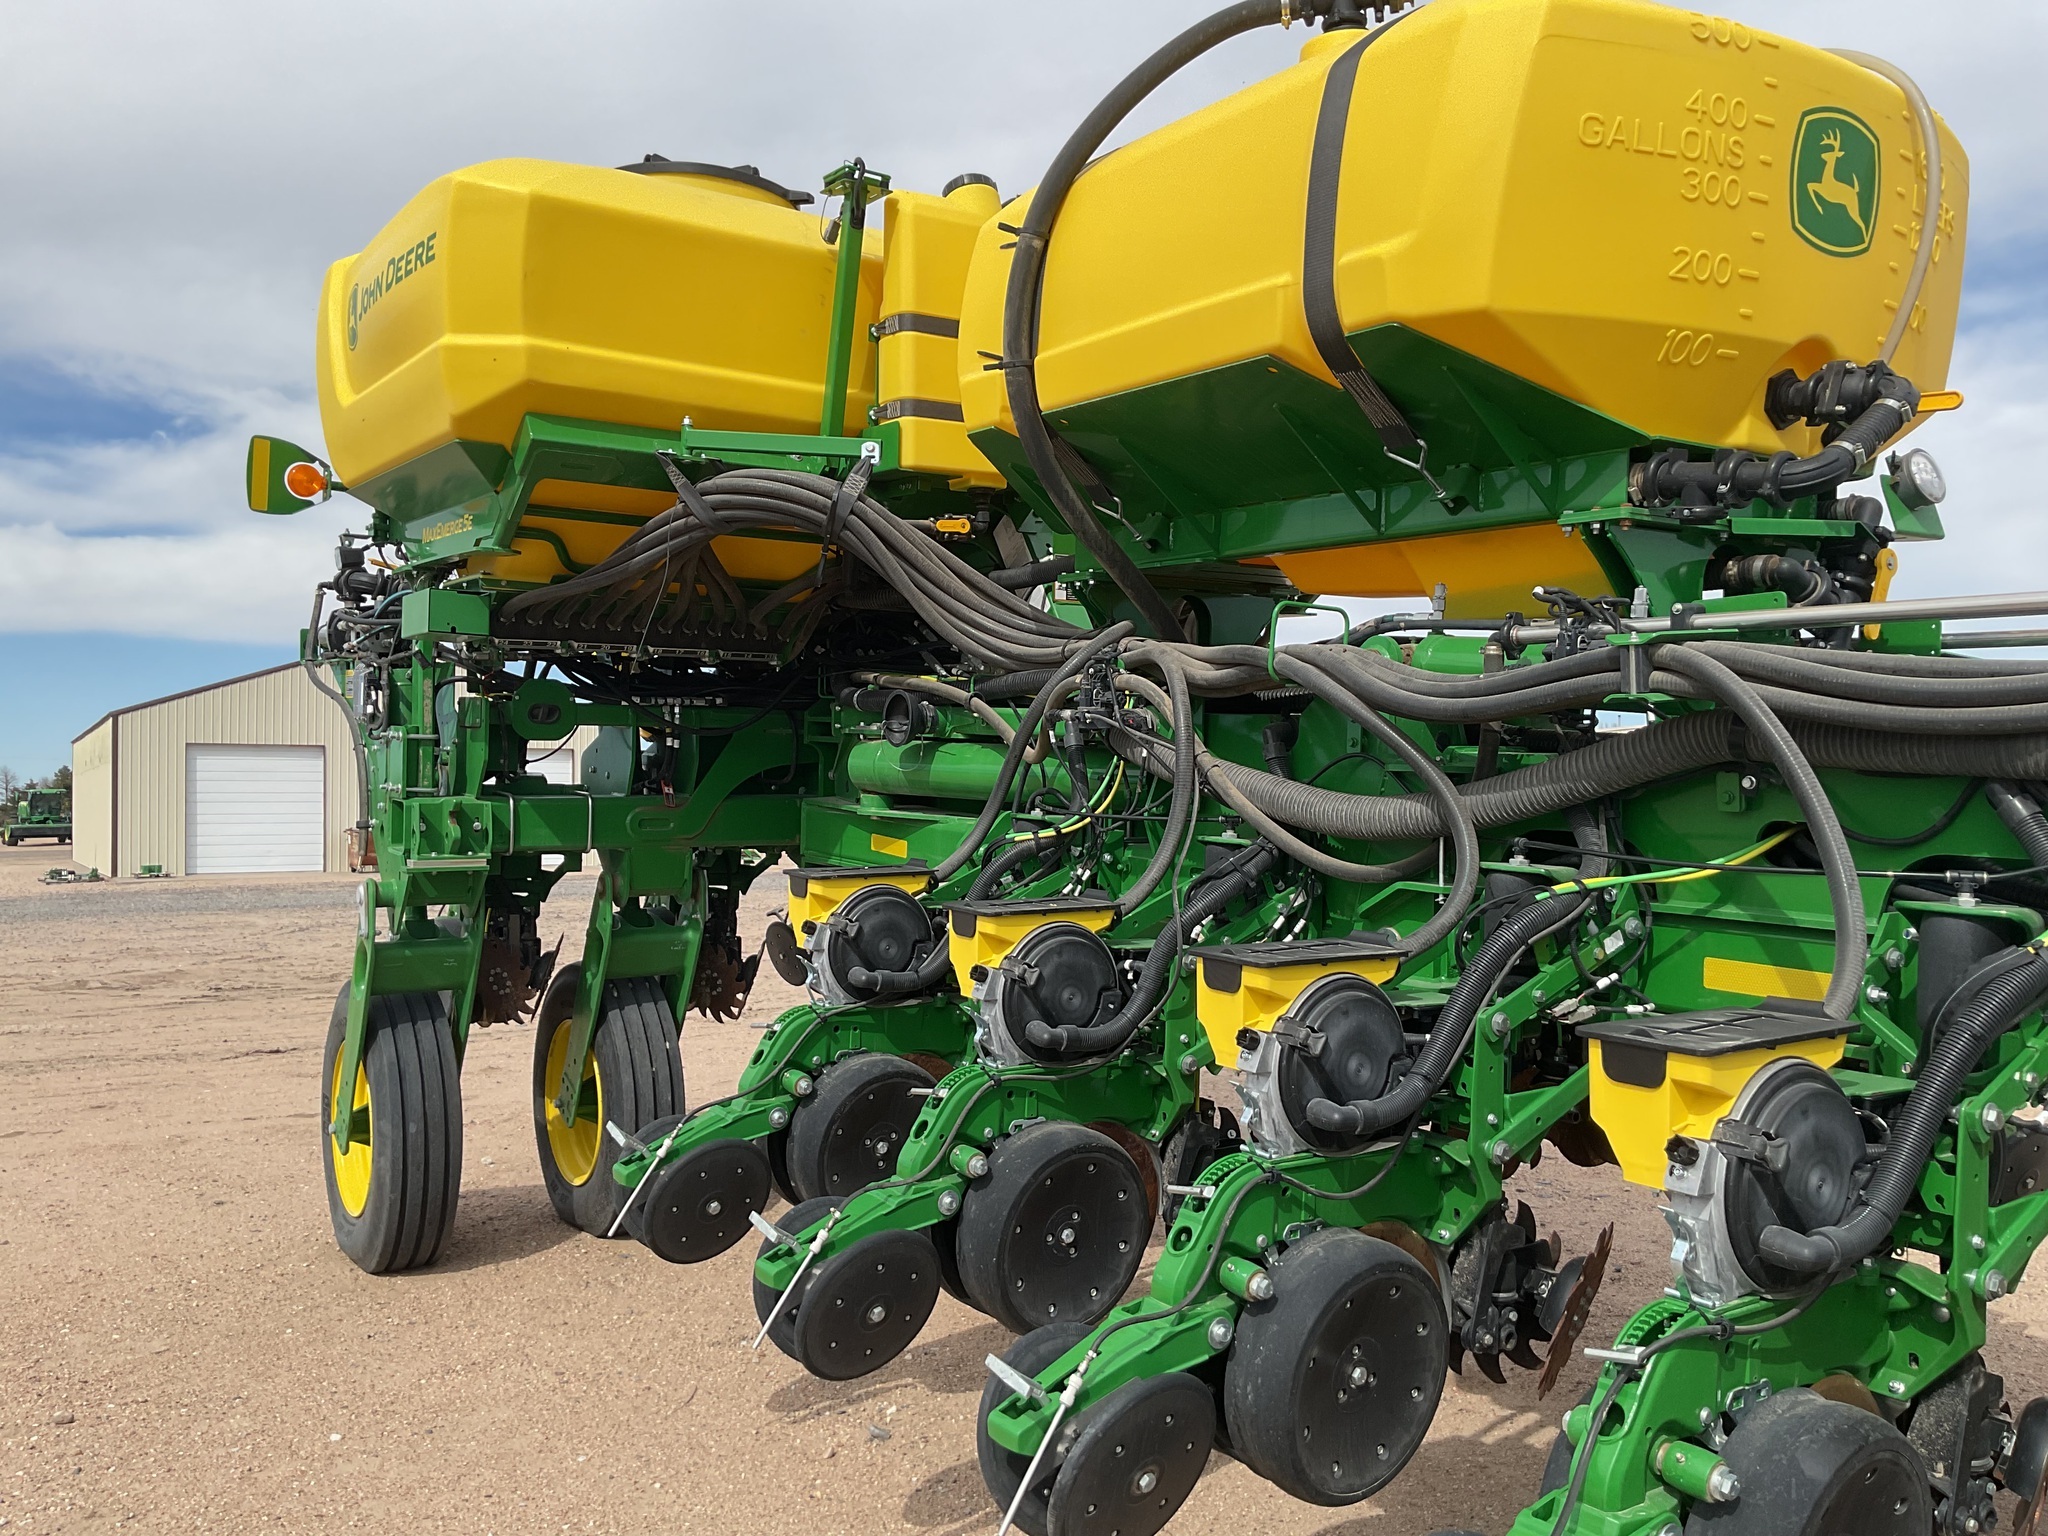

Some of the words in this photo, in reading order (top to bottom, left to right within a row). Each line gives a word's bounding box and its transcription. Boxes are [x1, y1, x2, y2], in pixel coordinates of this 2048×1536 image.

[1690, 12, 1750, 51] 500
[1685, 89, 1747, 130] 400
[1578, 112, 1745, 169] GALLONS
[1681, 167, 1742, 207] 300
[1911, 184, 1956, 239] LERS
[1909, 221, 1941, 264] 120
[358, 270, 385, 322] JOHN
[385, 231, 437, 293] DEERE
[1668, 246, 1732, 284] 200
[1657, 328, 1714, 366] 100
